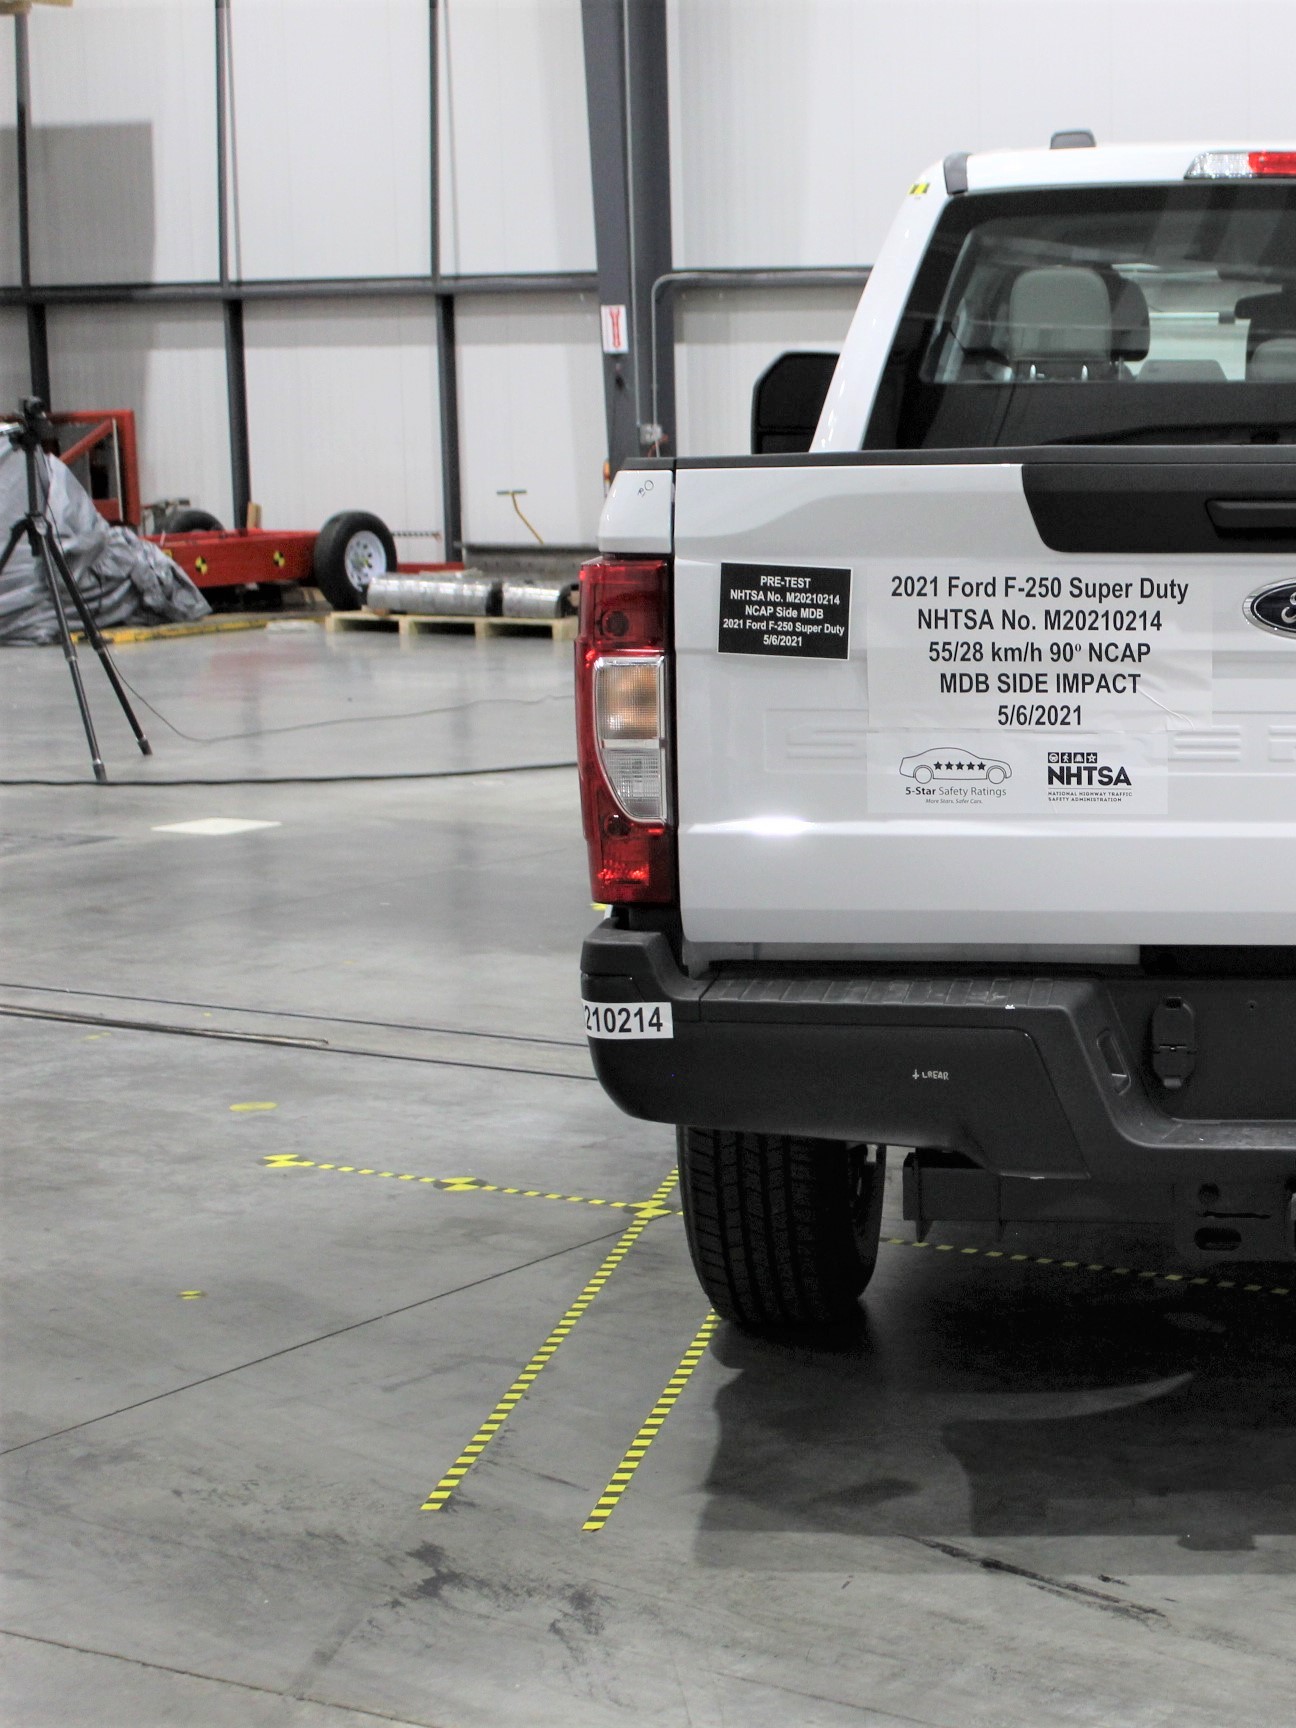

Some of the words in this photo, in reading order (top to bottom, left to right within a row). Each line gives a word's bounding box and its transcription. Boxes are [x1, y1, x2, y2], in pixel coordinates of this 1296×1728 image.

[760, 575, 811, 588] PRE-TEST
[891, 575, 939, 597] 2021
[948, 576, 997, 598] Ford
[1004, 576, 1062, 598] F-250
[1069, 577, 1133, 603] Super
[1140, 577, 1189, 605] Duty
[730, 589, 765, 601] NHTSA
[767, 591, 783, 602] No.
[786, 592, 840, 605] M20210214
[745, 605, 774, 616] NCAP
[776, 607, 798, 618] Side
[800, 608, 824, 619] MDB
[917, 608, 995, 630] NHTSA
[1001, 609, 1036, 630] No.
[1044, 609, 1163, 632] M20210214
[723, 618, 743, 629] 2021
[746, 620, 766, 630] Ford
[769, 621, 793, 631] F-250
[795, 623, 822, 634] Super
[824, 624, 845, 636] Duty
[763, 635, 802, 646] 5/6/2021
[928, 641, 984, 662] 55/28
[991, 642, 1042, 662] km/h
[1088, 643, 1151, 663] NCAP
[940, 673, 990, 693] MDB
[997, 673, 1048, 693] SIDE
[1056, 673, 1141, 694] IMPACT
[998, 705, 1082, 726] 5/6/2021
[1048, 766, 1132, 786] NHTSA
[905, 786, 936, 795] 5-Star
[938, 786, 968, 797] Safety
[970, 786, 1007, 798] Ratings
